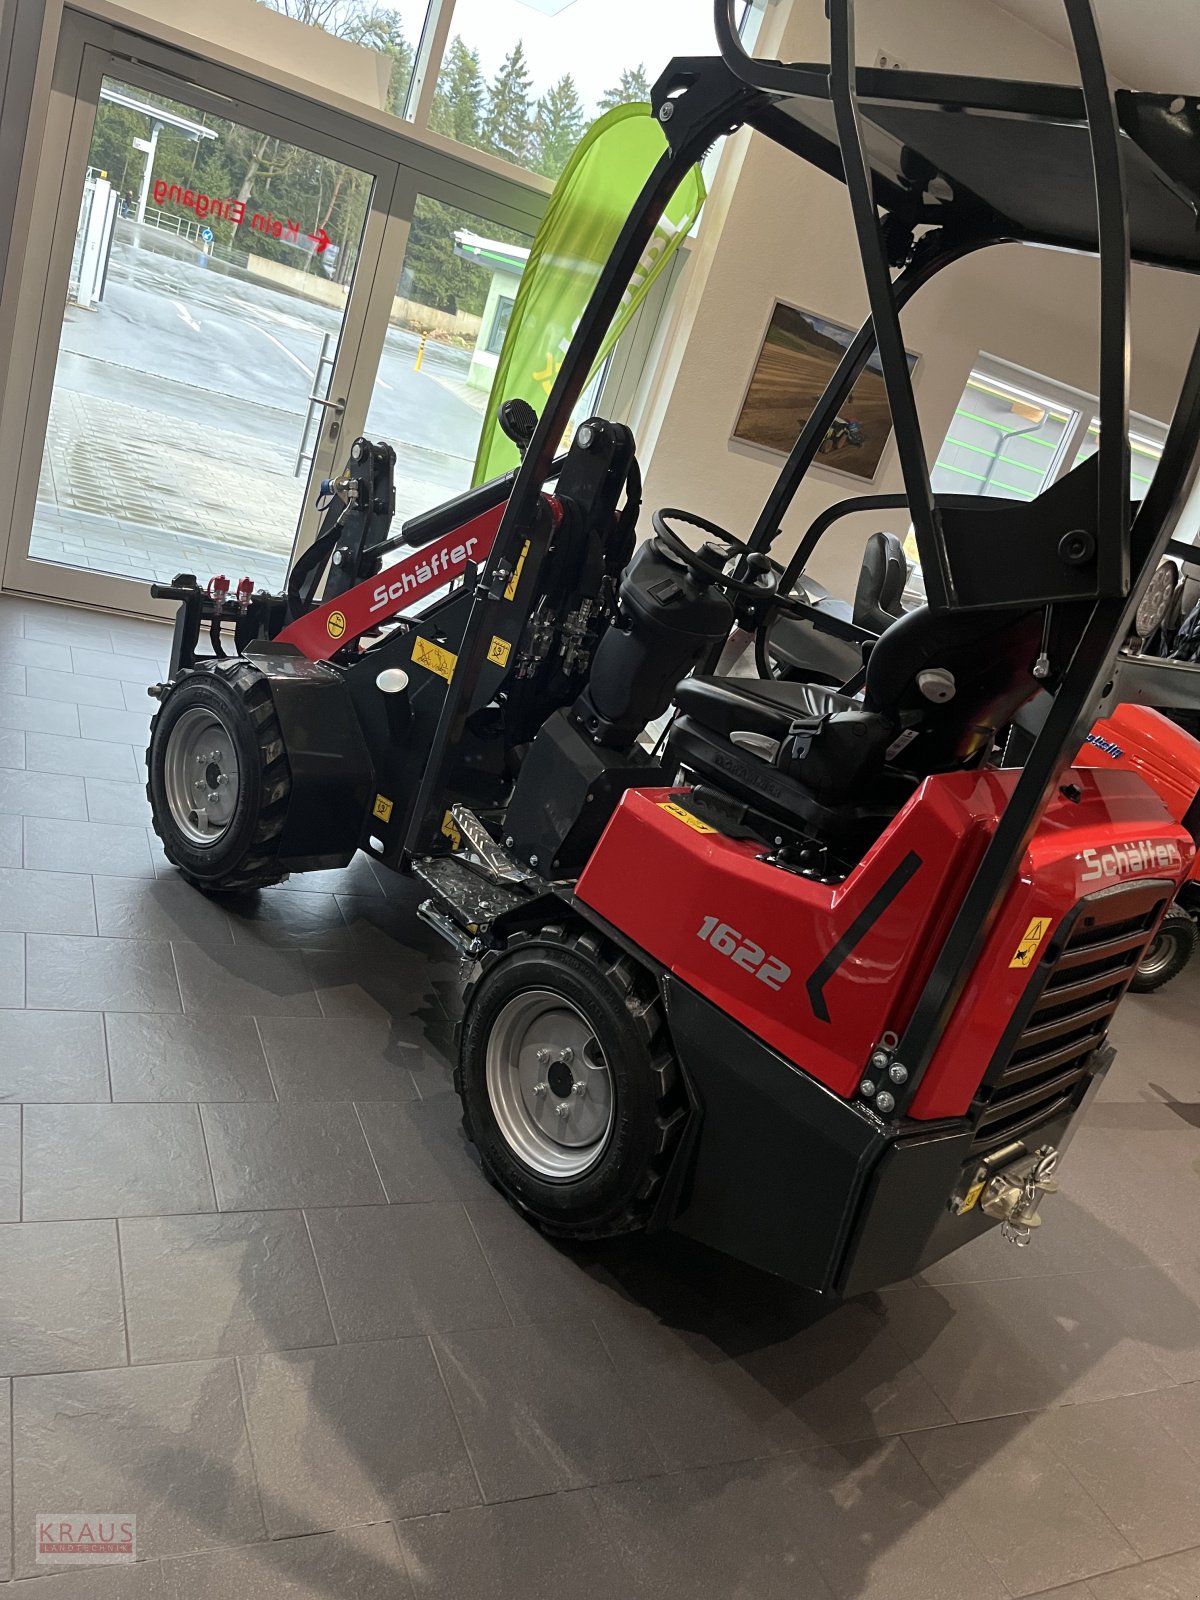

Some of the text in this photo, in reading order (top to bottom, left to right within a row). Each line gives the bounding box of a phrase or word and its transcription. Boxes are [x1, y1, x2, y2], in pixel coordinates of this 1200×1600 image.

[369, 537, 478, 613] Schäffer
[1081, 840, 1176, 881] Schäffer
[696, 915, 792, 991] 1622
